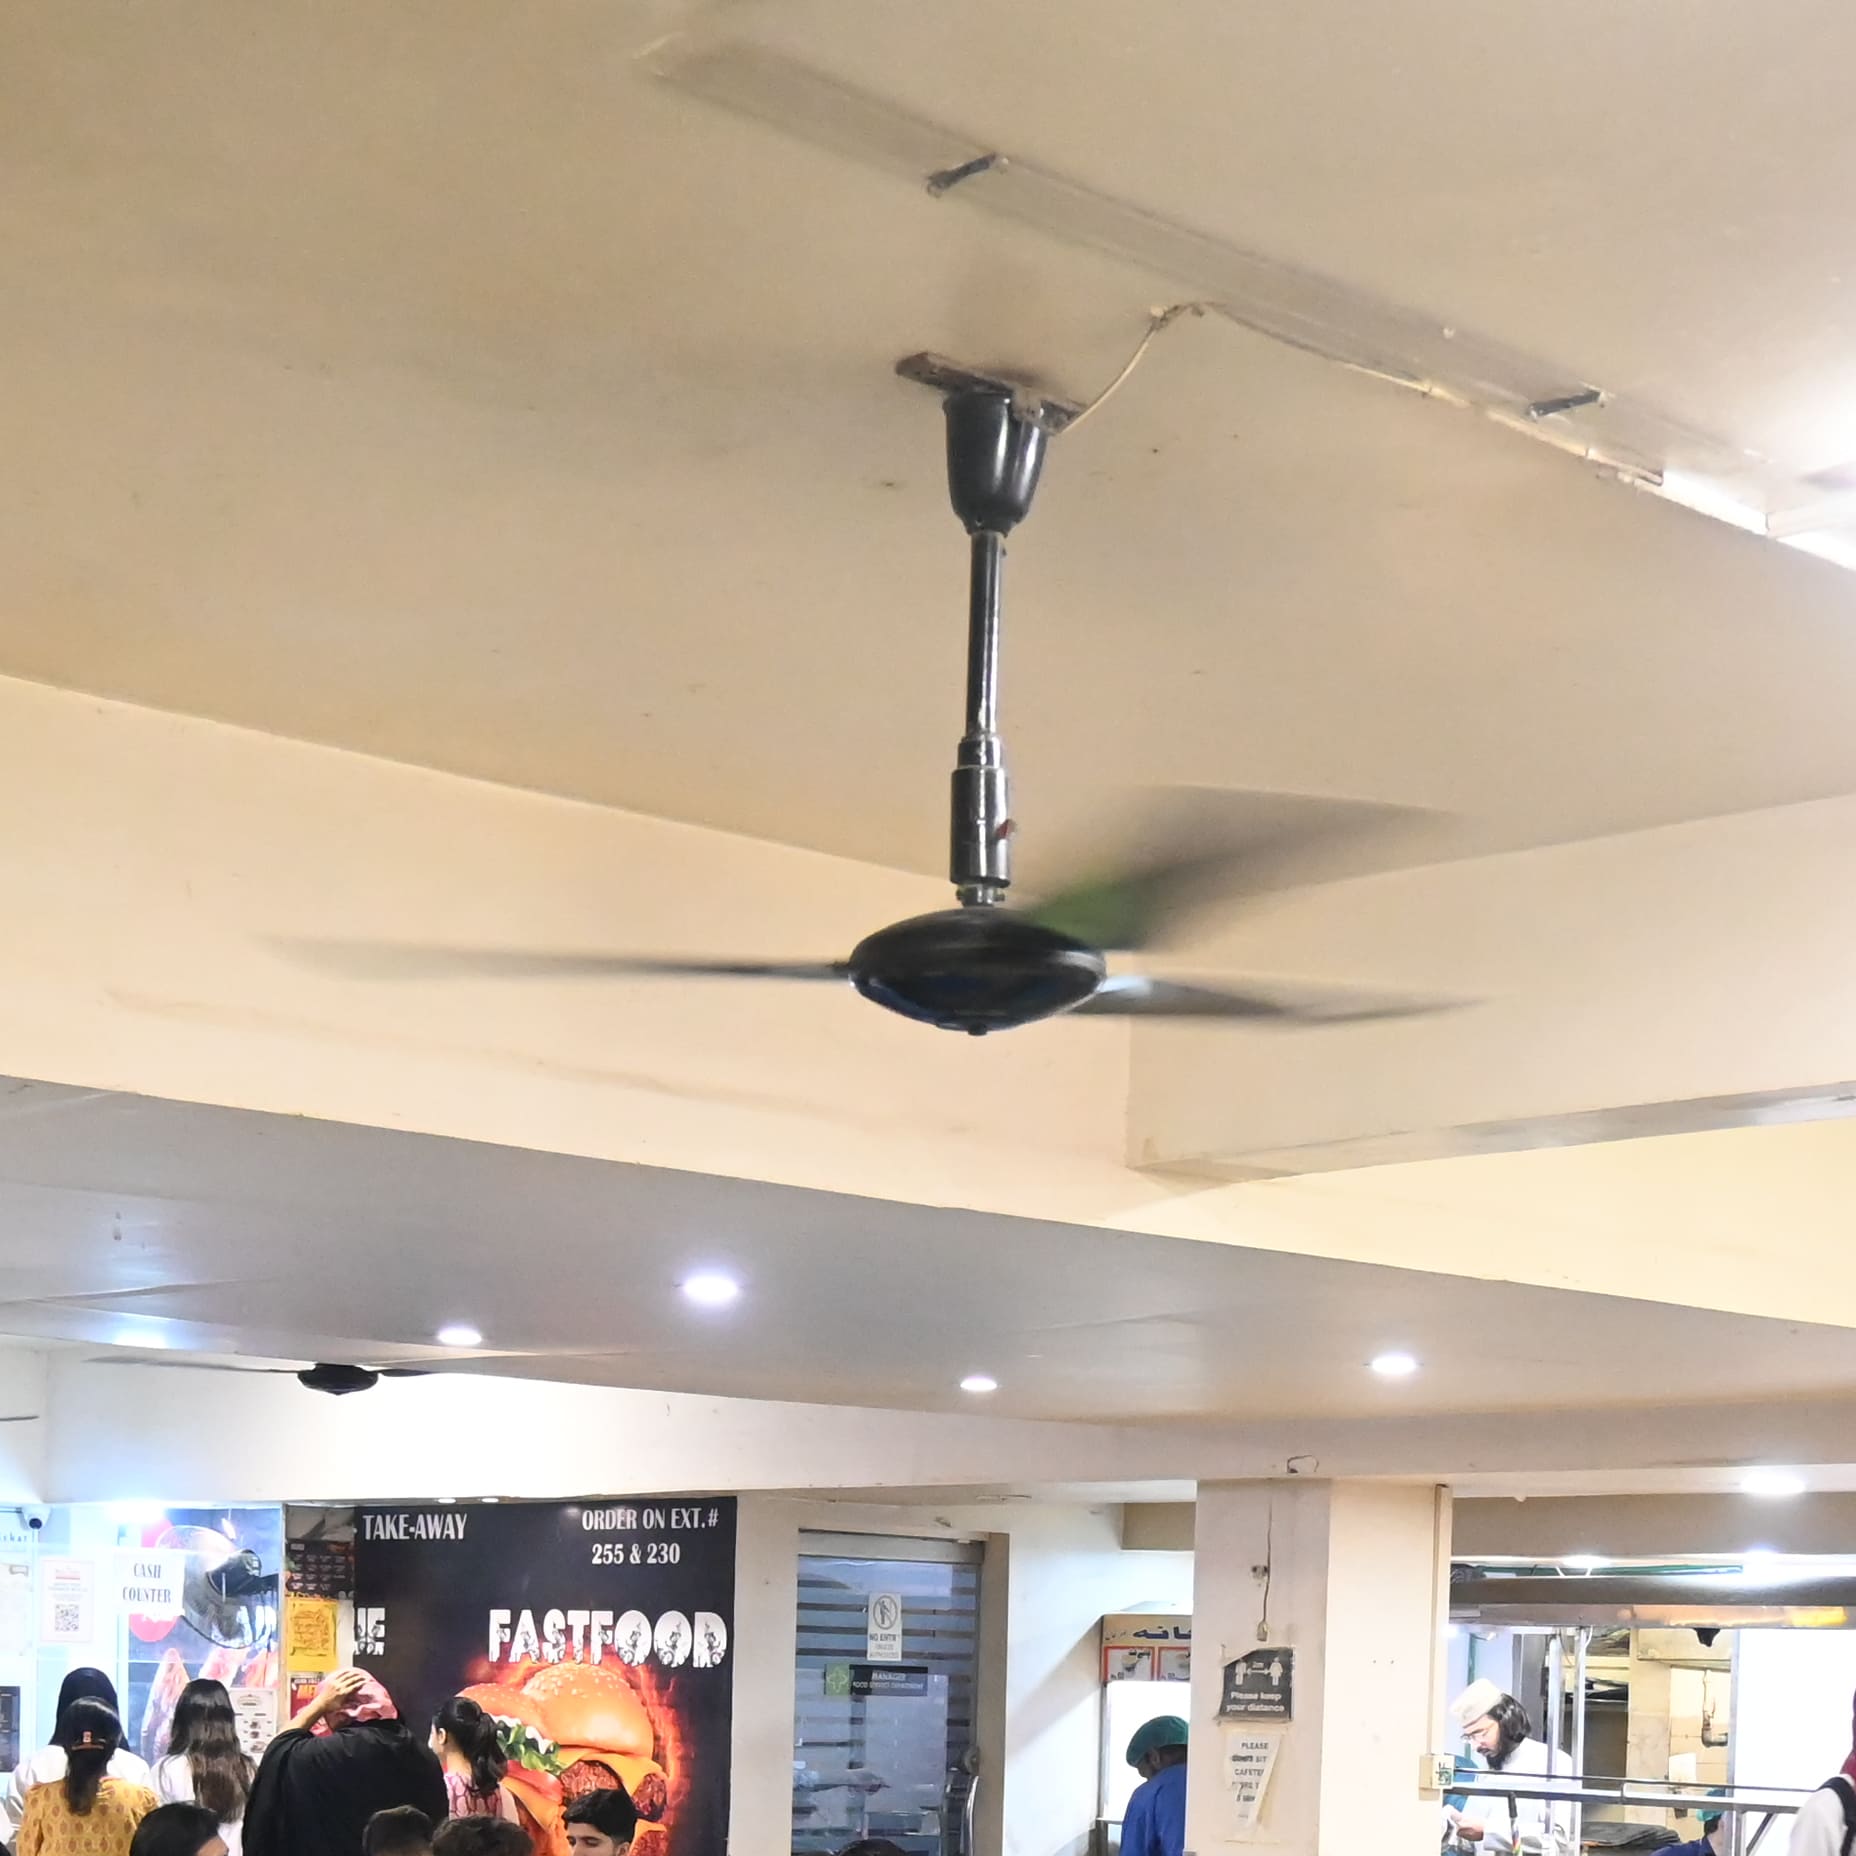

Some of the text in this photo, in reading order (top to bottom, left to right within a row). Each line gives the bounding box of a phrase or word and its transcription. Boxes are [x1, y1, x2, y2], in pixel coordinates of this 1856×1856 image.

[363, 1513, 468, 1540] TAKE-AWAY
[582, 1509, 637, 1531] ORDER
[644, 1509, 665, 1530] ON
[591, 1543, 681, 1565] 255 & 230
[133, 1563, 162, 1578] CASH
[122, 1587, 171, 1604] COUNTER
[488, 1608, 728, 1668] FASTFOOD
[1231, 1692, 1282, 1702] Please keep
[1226, 1702, 1285, 1713] your distance
[1241, 1742, 1269, 1750] PLEASE
